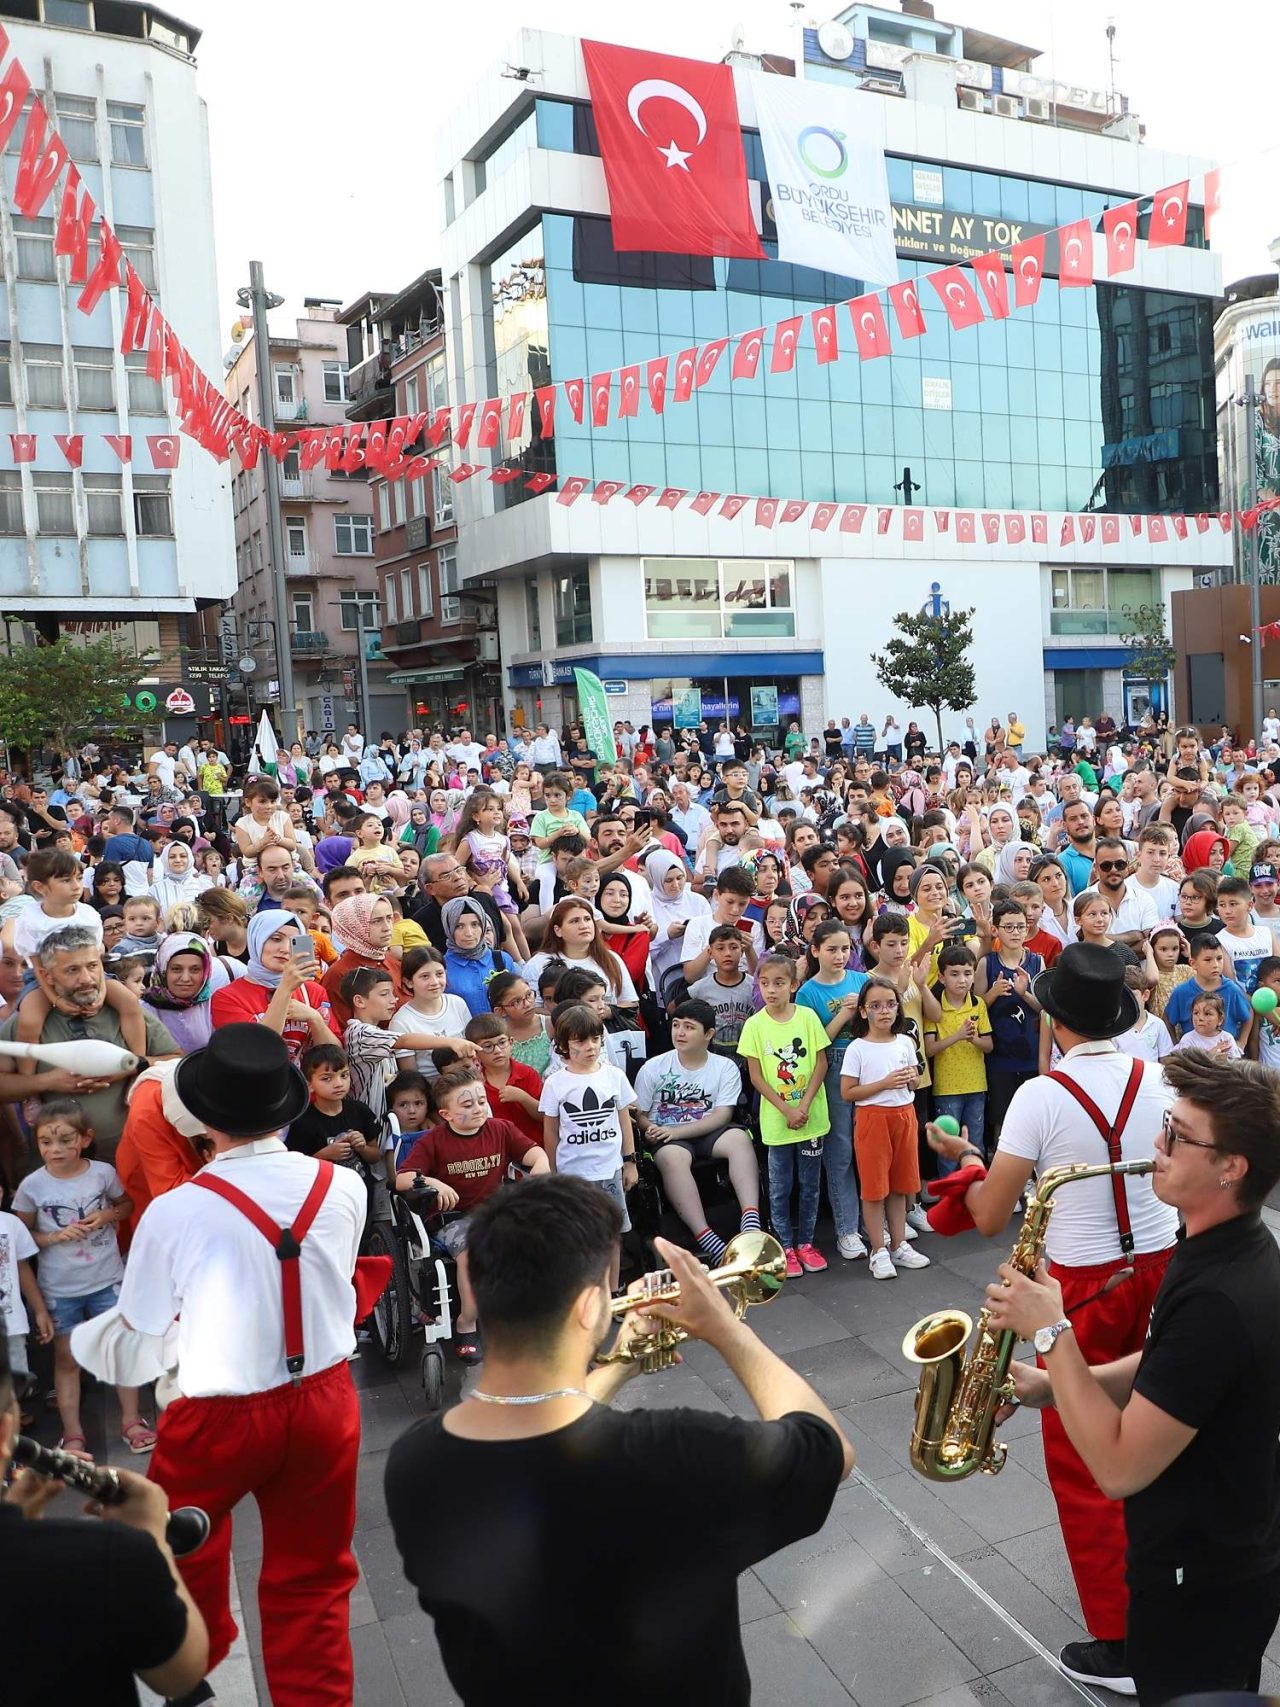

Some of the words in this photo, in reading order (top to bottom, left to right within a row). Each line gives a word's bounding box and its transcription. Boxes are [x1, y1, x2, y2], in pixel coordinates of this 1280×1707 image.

[808, 182, 849, 201] ORDU
[777, 183, 888, 228] BÜYÜKŞEHİR
[801, 207, 872, 239] BELEDİYESİ
[891, 205, 943, 240] NNET
[950, 216, 974, 241] AY
[983, 220, 1023, 247] TOK
[933, 243, 945, 252] ve
[950, 243, 984, 259] Doğum
[322, 696, 333, 729] CASIO
[566, 1127, 617, 1146] adidas
[476, 1169, 489, 1178] YORK
